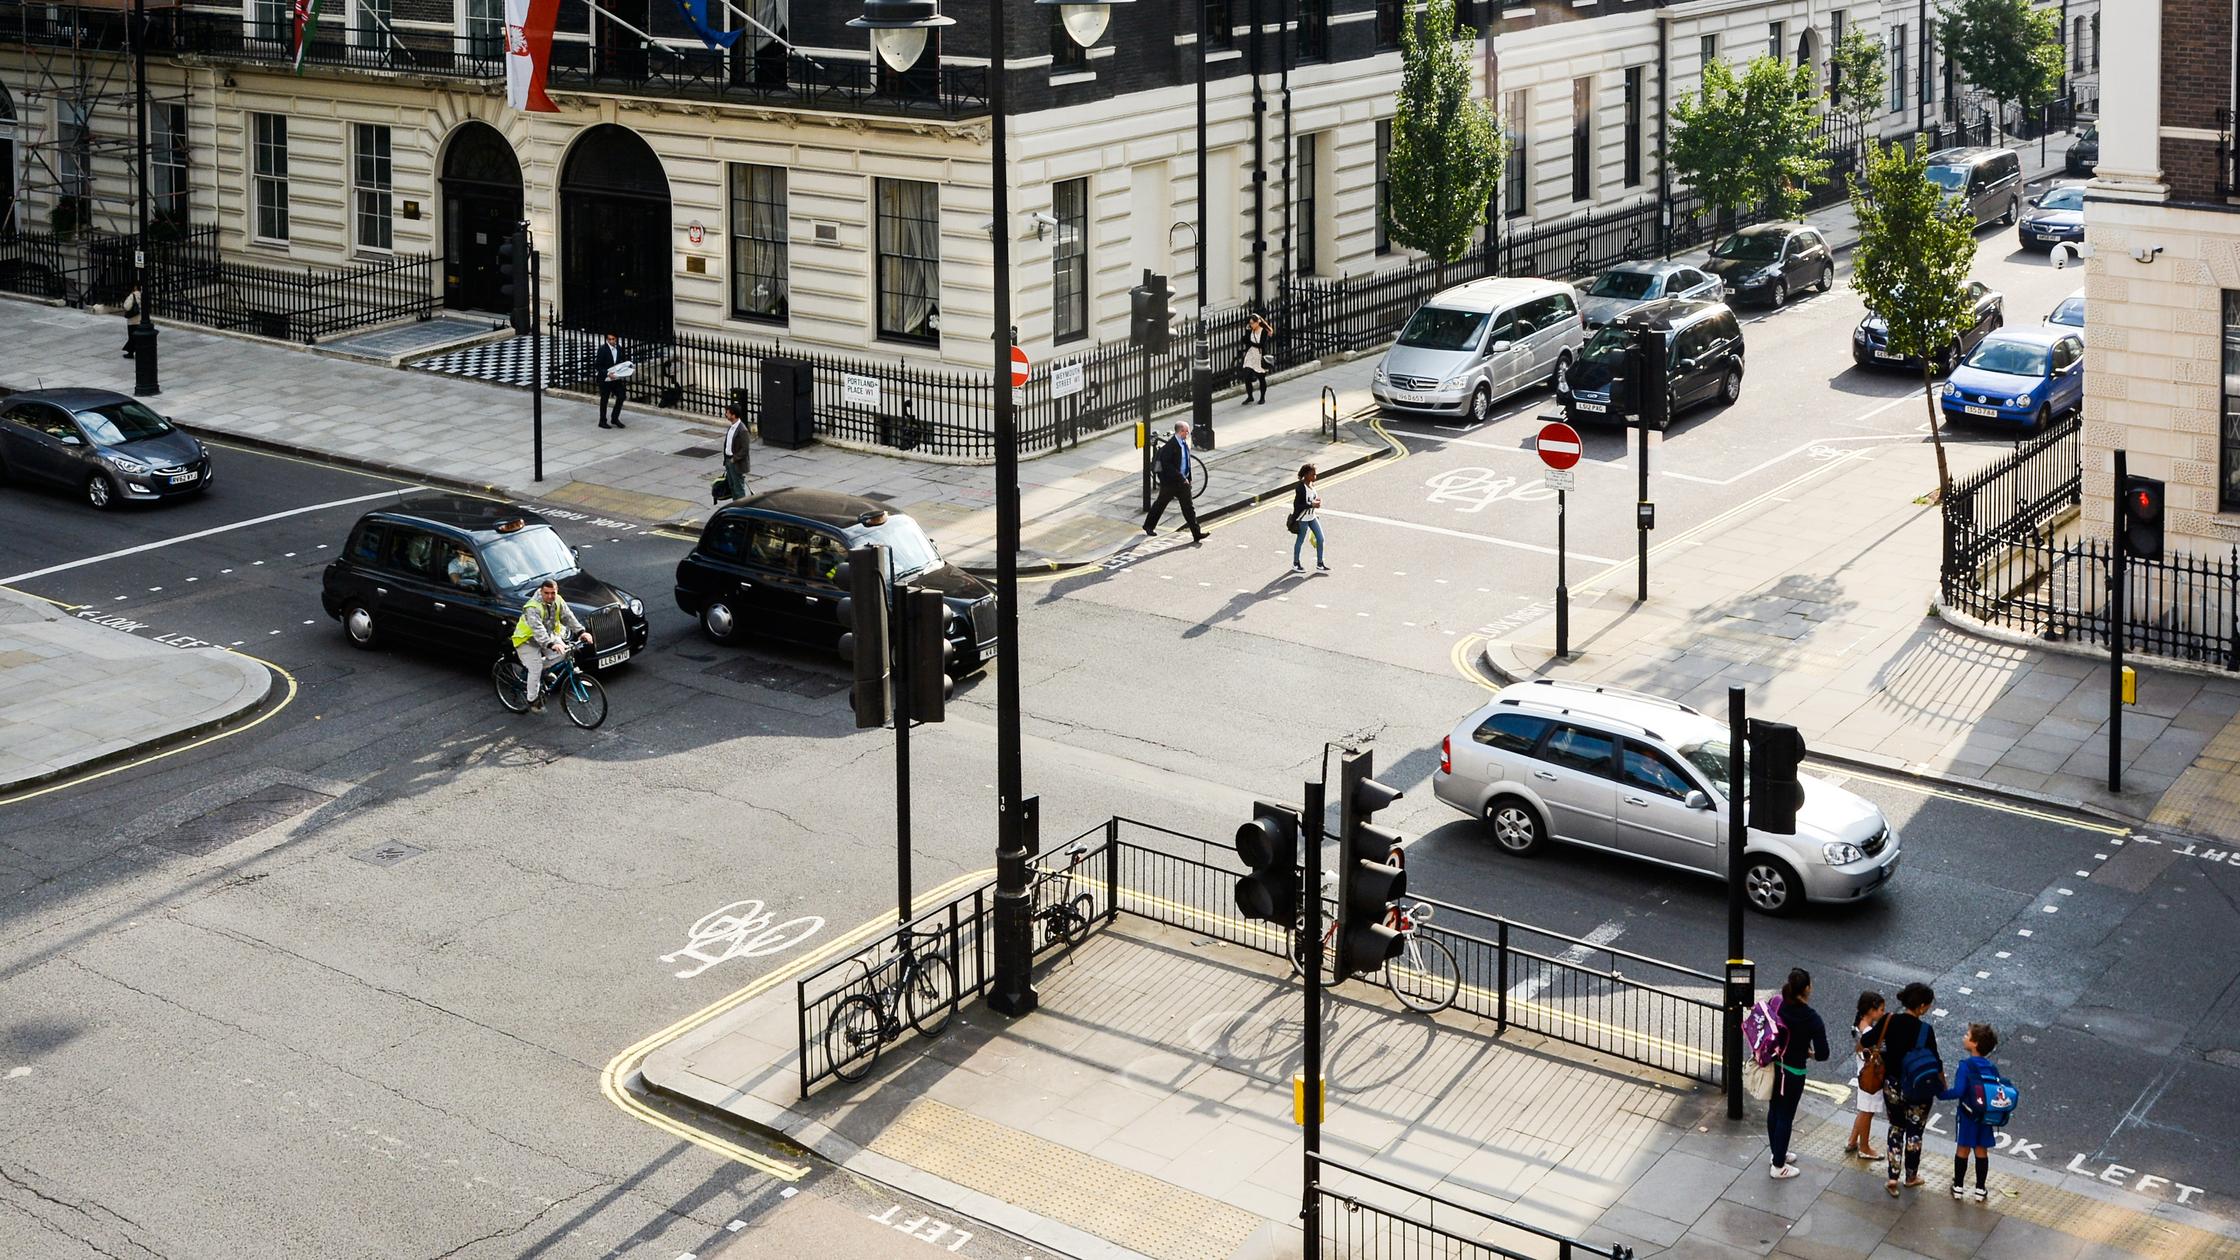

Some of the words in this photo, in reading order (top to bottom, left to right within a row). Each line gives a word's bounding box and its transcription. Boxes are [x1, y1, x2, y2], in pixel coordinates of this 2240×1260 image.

[1055, 367, 1080, 380] WEYMOUTH
[847, 377, 875, 388] PORTLAND
[1055, 378, 1072, 389] STREET
[847, 385, 863, 395] PLACE
[864, 387, 874, 396] W1
[529, 508, 589, 520] RIGHT
[586, 518, 638, 530] LOOK
[89, 614, 149, 633] LOOK
[1925, 1113, 2043, 1160] LOK
[2066, 1153, 2204, 1204] LEFT
[868, 1205, 973, 1251] LEFT
